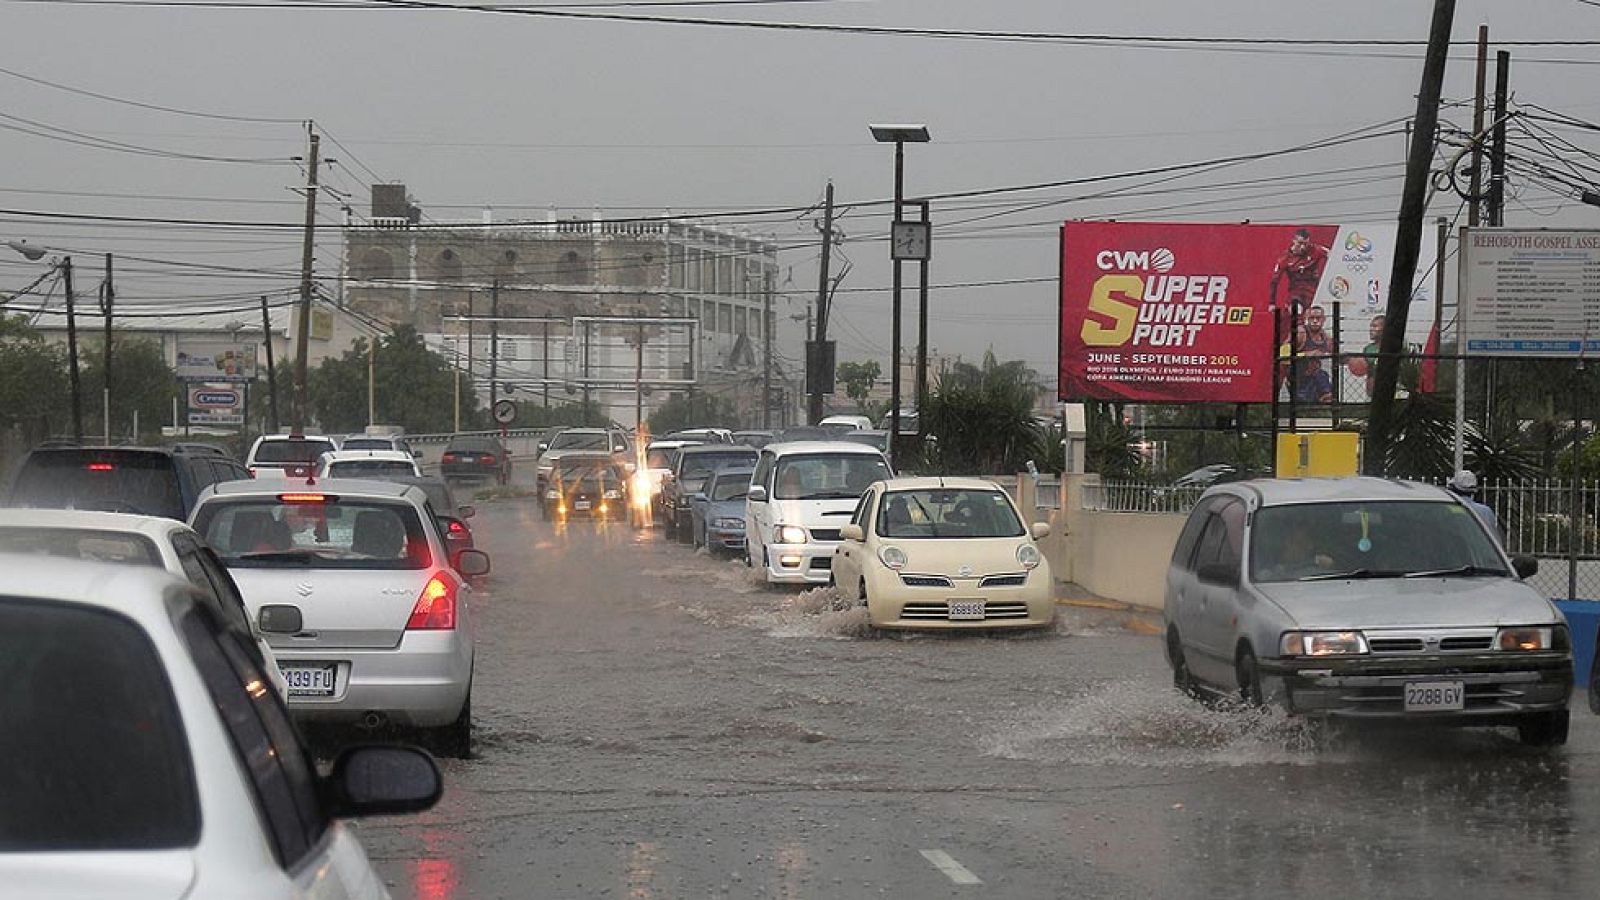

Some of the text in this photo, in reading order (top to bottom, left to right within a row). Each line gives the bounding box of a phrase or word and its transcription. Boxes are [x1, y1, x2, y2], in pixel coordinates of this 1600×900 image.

[1473, 236, 1532, 248] REHOBOTH
[1534, 236, 1572, 249] GOSPEL
[1096, 251, 1149, 270] CVM
[1229, 309, 1250, 323] OF
[1088, 353, 1121, 364] JUNE
[1132, 354, 1207, 365] SEPTEMBER
[1210, 355, 1239, 365] 2016
[313, 670, 331, 687] FU
[1408, 688, 1461, 704] 2288 GV
